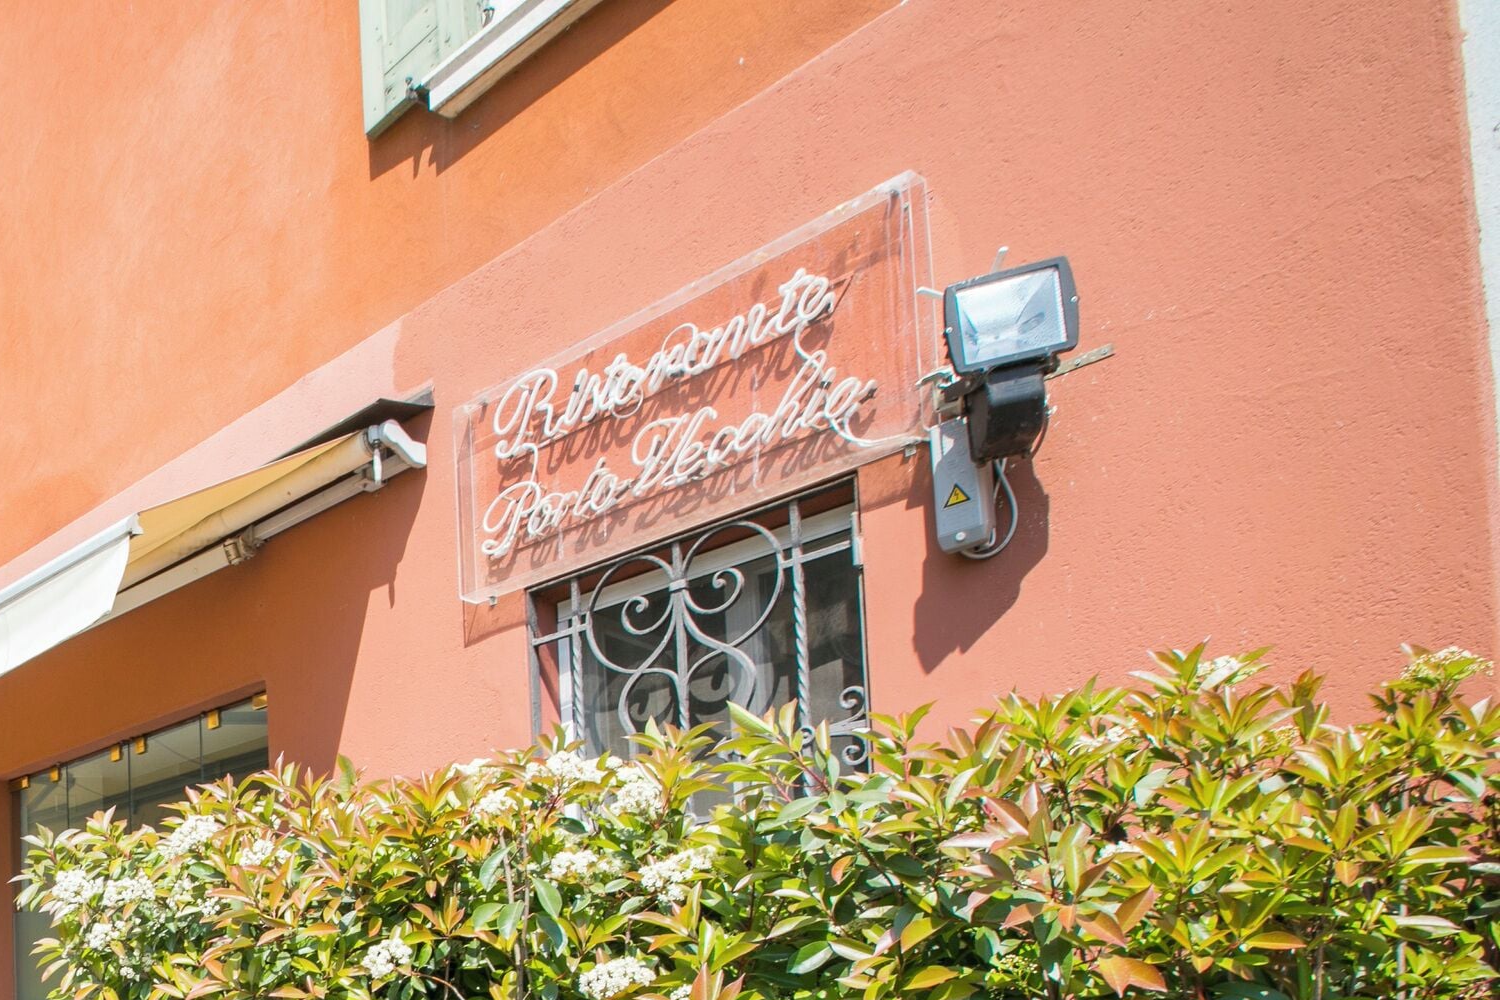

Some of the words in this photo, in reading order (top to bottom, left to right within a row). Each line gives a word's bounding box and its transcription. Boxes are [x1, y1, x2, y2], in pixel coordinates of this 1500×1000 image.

[481, 459, 625, 558] Porto
[631, 350, 876, 497] Vecchio
[493, 267, 836, 460] Ristorante
